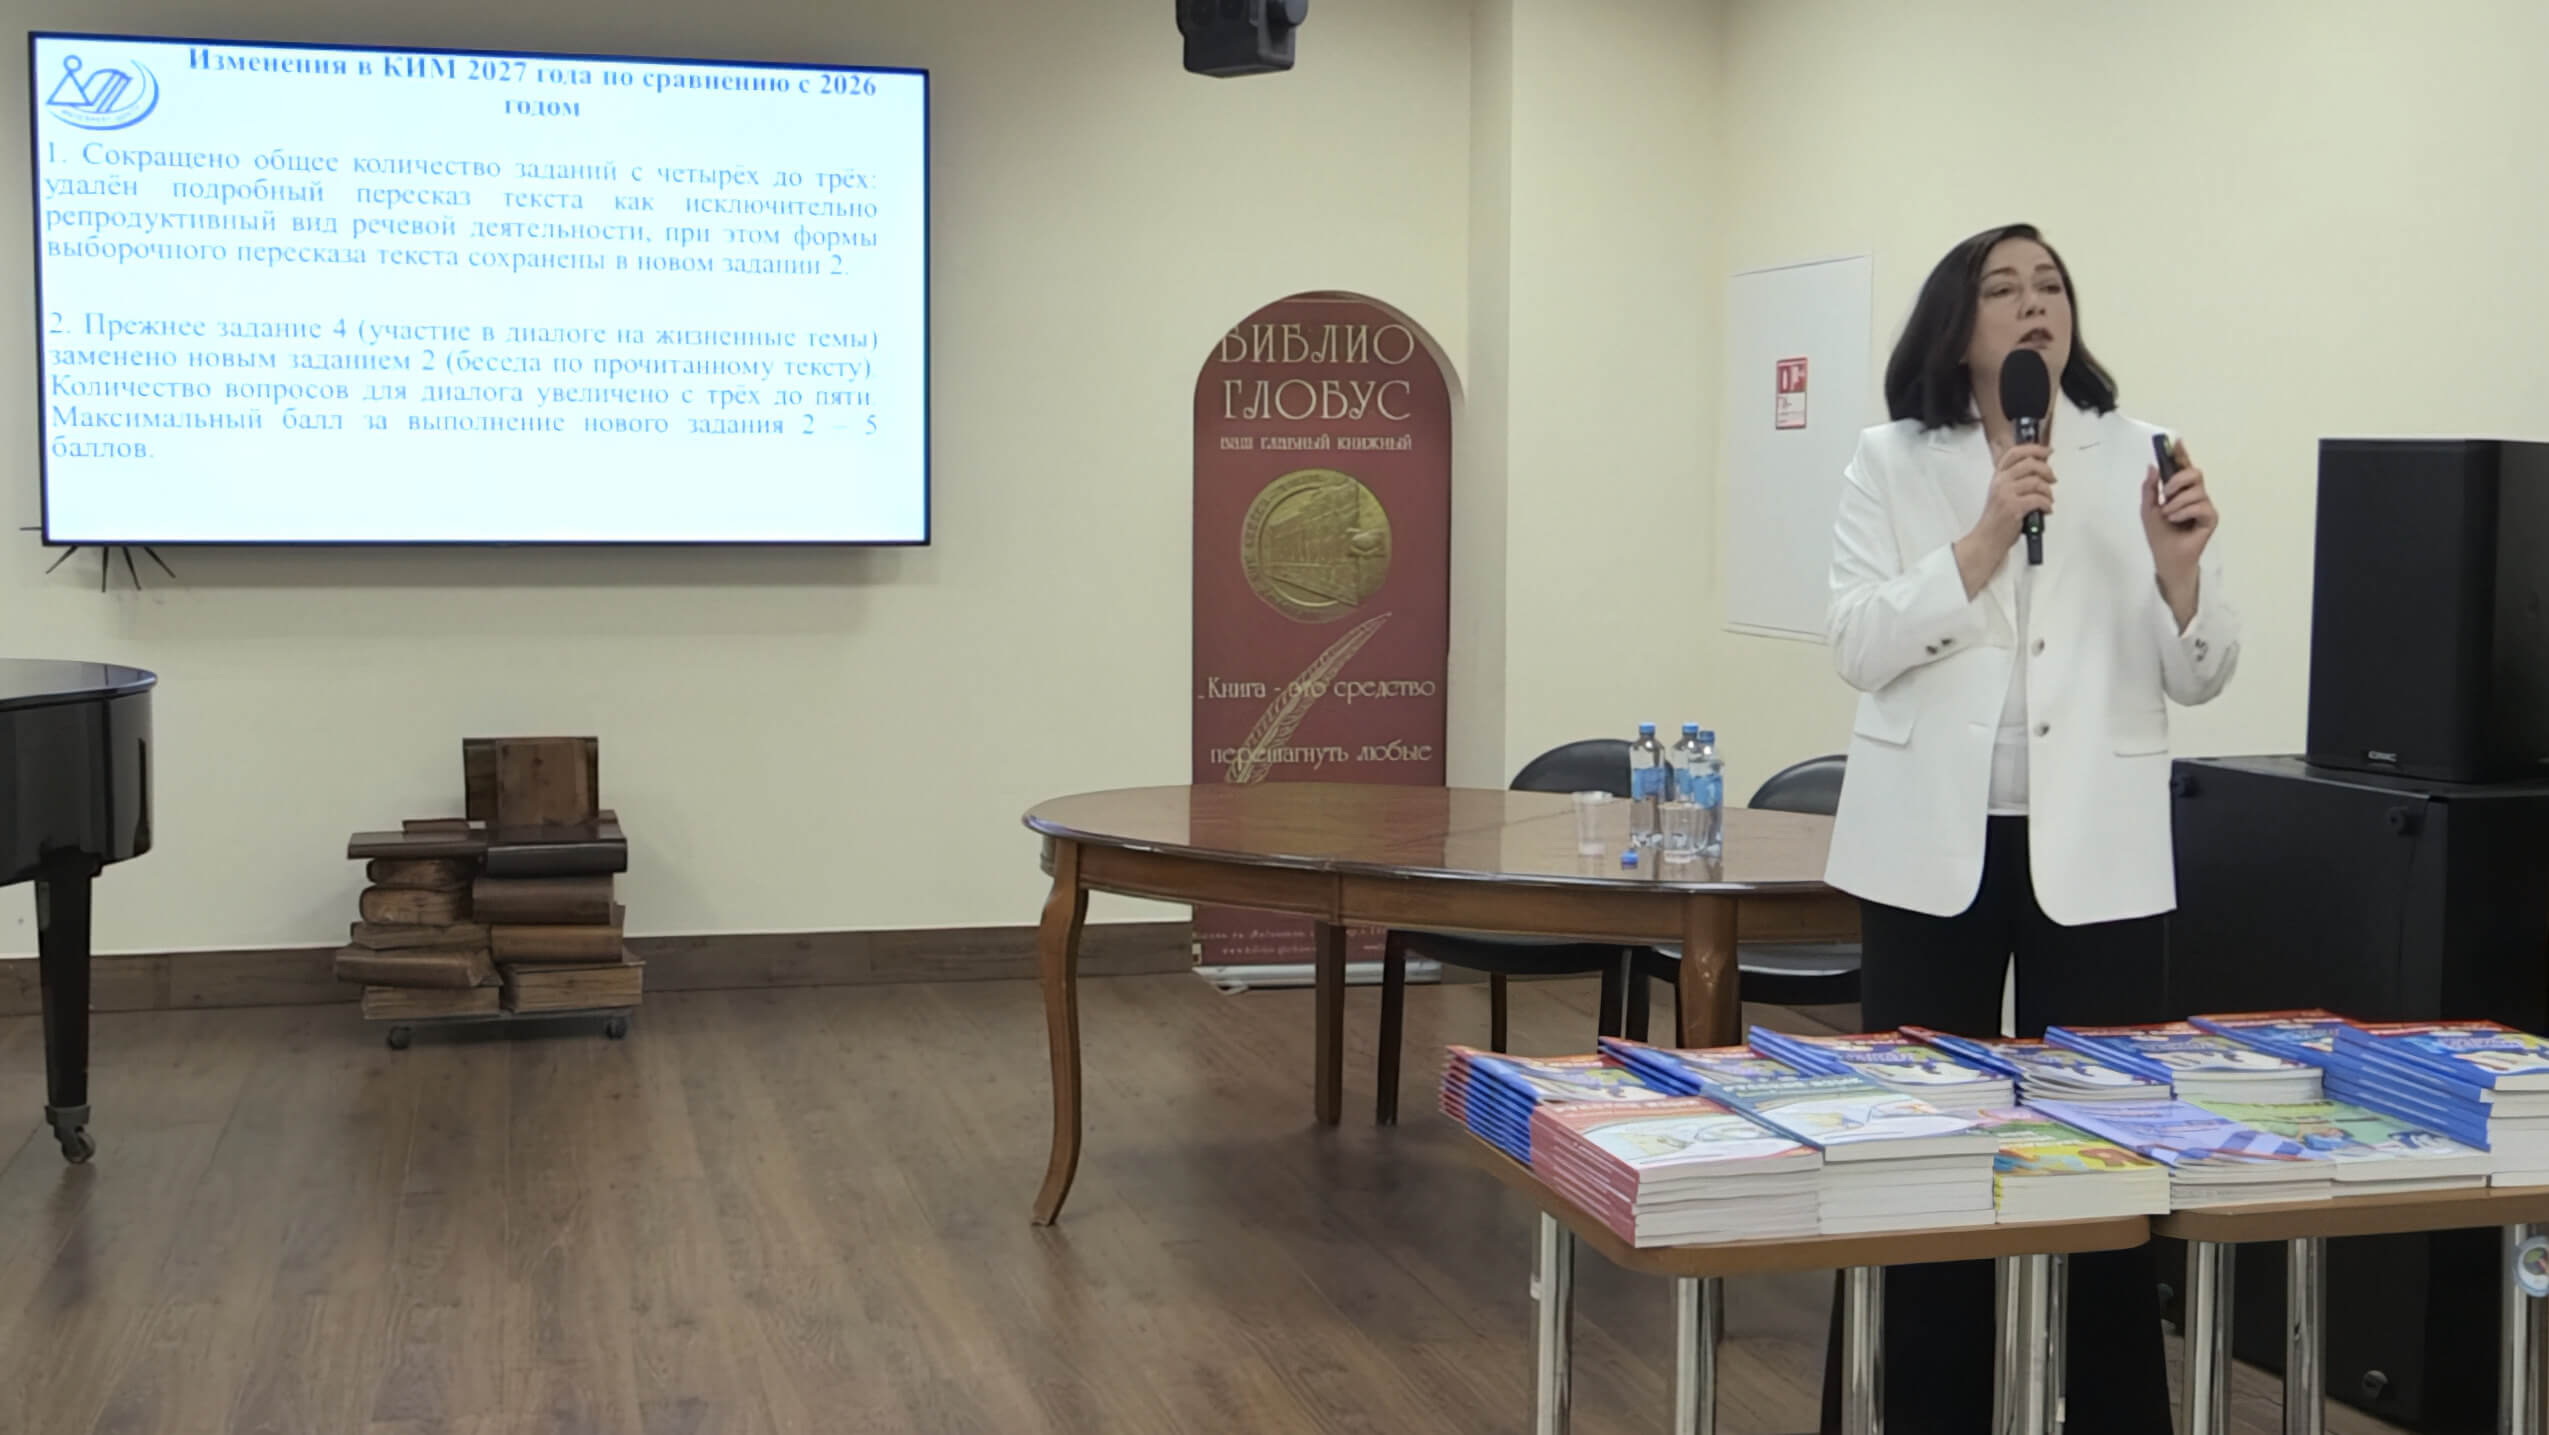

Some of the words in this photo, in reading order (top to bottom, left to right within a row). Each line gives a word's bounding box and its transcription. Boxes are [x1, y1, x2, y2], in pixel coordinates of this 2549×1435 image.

[189, 48, 346, 75] Изменения
[358, 60, 372, 76] в
[384, 56, 455, 79] КИМ
[467, 60, 526, 82] 2027
[537, 68, 592, 85] года
[603, 70, 634, 86] по
[642, 72, 790, 94] сравнению
[798, 79, 810, 94] с
[819, 74, 876, 96] 2026
[505, 100, 580, 117] годом
[82, 142, 240, 172] Сокращено
[254, 148, 338, 173] общее
[354, 158, 501, 177] количество
[516, 162, 616, 181] заданий
[631, 166, 643, 182] с
[658, 165, 759, 191] четырёх
[773, 172, 802, 187] до
[45, 174, 137, 200] удалён
[173, 178, 323, 205] подробный
[357, 188, 471, 210] пересказ
[504, 192, 583, 208] текста
[615, 196, 654, 211] как
[686, 198, 878, 218] исключительно
[46, 210, 275, 234] репродуктивный
[293, 216, 338, 234] вид
[353, 216, 455, 240] речевой
[470, 222, 651, 243] деятельности,
[666, 227, 709, 248] при
[725, 229, 779, 244] этом
[794, 224, 877, 252] формы
[47, 235, 227, 264] выборочного
[238, 246, 366, 267] пересказа
[378, 249, 458, 265] текста
[468, 252, 604, 273] сохранены
[617, 256, 627, 270] в
[638, 256, 712, 272] новом
[85, 312, 205, 341] Прежнее
[217, 322, 322, 339] задание
[333, 318, 346, 338] 4
[358, 320, 470, 346] (участие
[482, 326, 495, 341] в
[505, 327, 606, 344] диалоге
[618, 329, 644, 344] на
[656, 330, 796, 347] жизненные
[809, 330, 877, 352] темы)
[1219, 323, 1415, 365] БИБЛИО
[49, 350, 177, 366] заменено
[189, 352, 275, 368] новым
[288, 352, 410, 371] заданием
[422, 349, 435, 371] 2
[446, 349, 541, 374] (беседа
[554, 357, 583, 373] по
[594, 358, 773, 381] прочитанному
[51, 374, 211, 398] Количество
[226, 383, 348, 405] вопросов
[363, 384, 406, 401] для
[421, 386, 523, 402] диалога
[537, 387, 669, 408] увеличено
[682, 389, 693, 404] с
[707, 384, 760, 410] трёх
[774, 390, 803, 406] до
[1223, 379, 1411, 420] ГЛОБУС
[52, 405, 262, 429] Максимальный
[282, 408, 342, 430] балл
[365, 414, 387, 431] за
[409, 416, 564, 432] выполнение
[585, 417, 668, 433] нового
[688, 419, 783, 434] задания
[802, 413, 814, 435] 2
[865, 414, 877, 435] 5
[1208, 676, 1266, 698] Книга
[1333, 680, 1436, 704] средство
[1210, 746, 1349, 771] перешагнуть
[1356, 739, 1433, 761] любые
